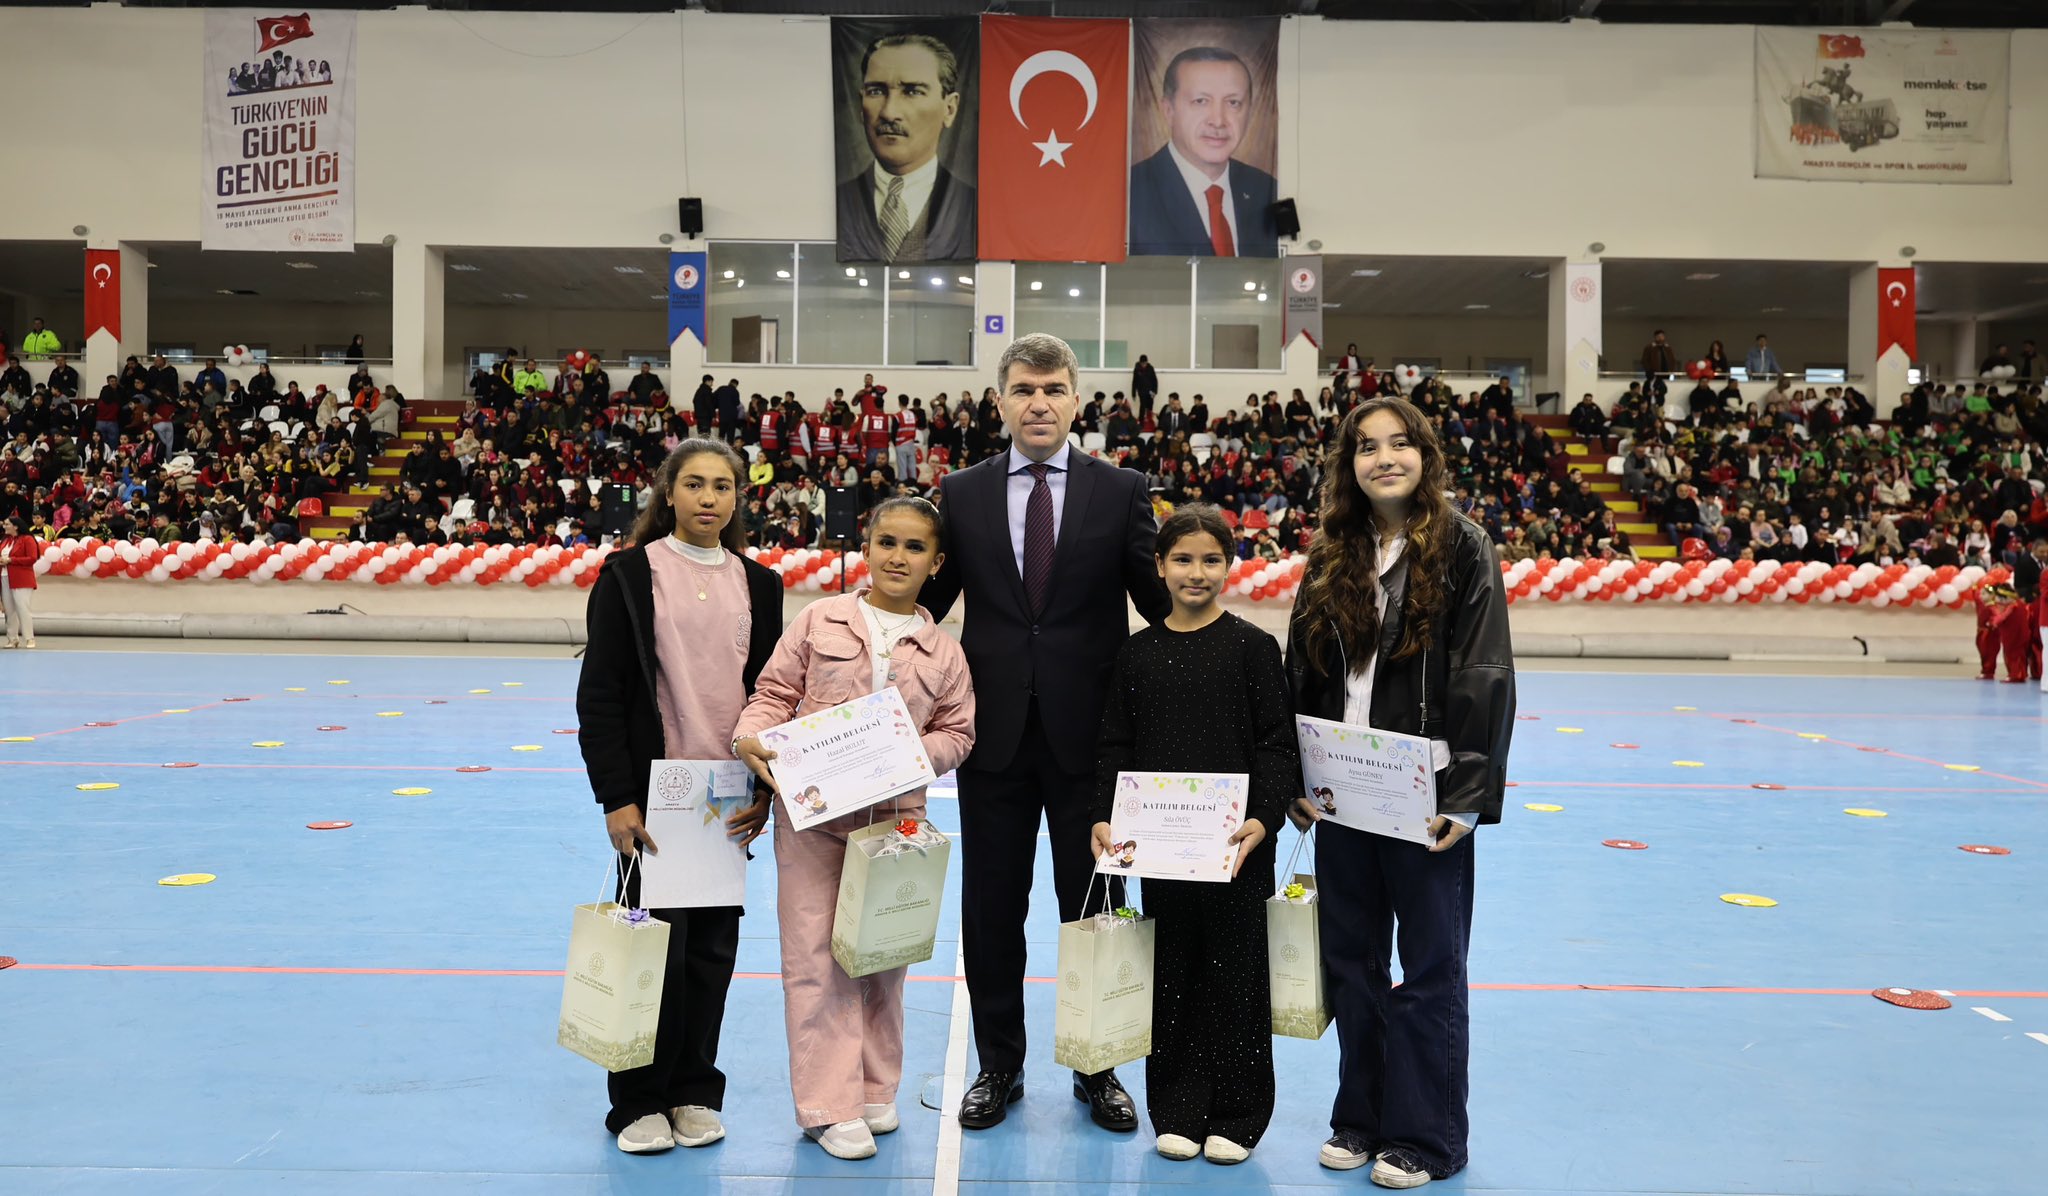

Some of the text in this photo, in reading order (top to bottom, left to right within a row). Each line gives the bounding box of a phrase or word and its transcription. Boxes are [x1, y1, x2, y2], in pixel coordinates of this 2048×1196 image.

[231, 96, 328, 125] TÜRKİYE'NİN
[242, 120, 317, 160] GÜCÜ
[217, 151, 339, 197] GENÇLİĞİ
[284, 204, 301, 212] ANMA
[304, 201, 328, 210] GENÇLİK
[226, 220, 242, 229] SPOR
[245, 217, 285, 227] BAYRAMIMIZ
[989, 319, 999, 330] C
[802, 719, 881, 754] KATILIM BELGESİ
[1328, 752, 1402, 772] KATILIM BELGESİ
[1143, 803, 1216, 812] KATILIM BELGESİ
